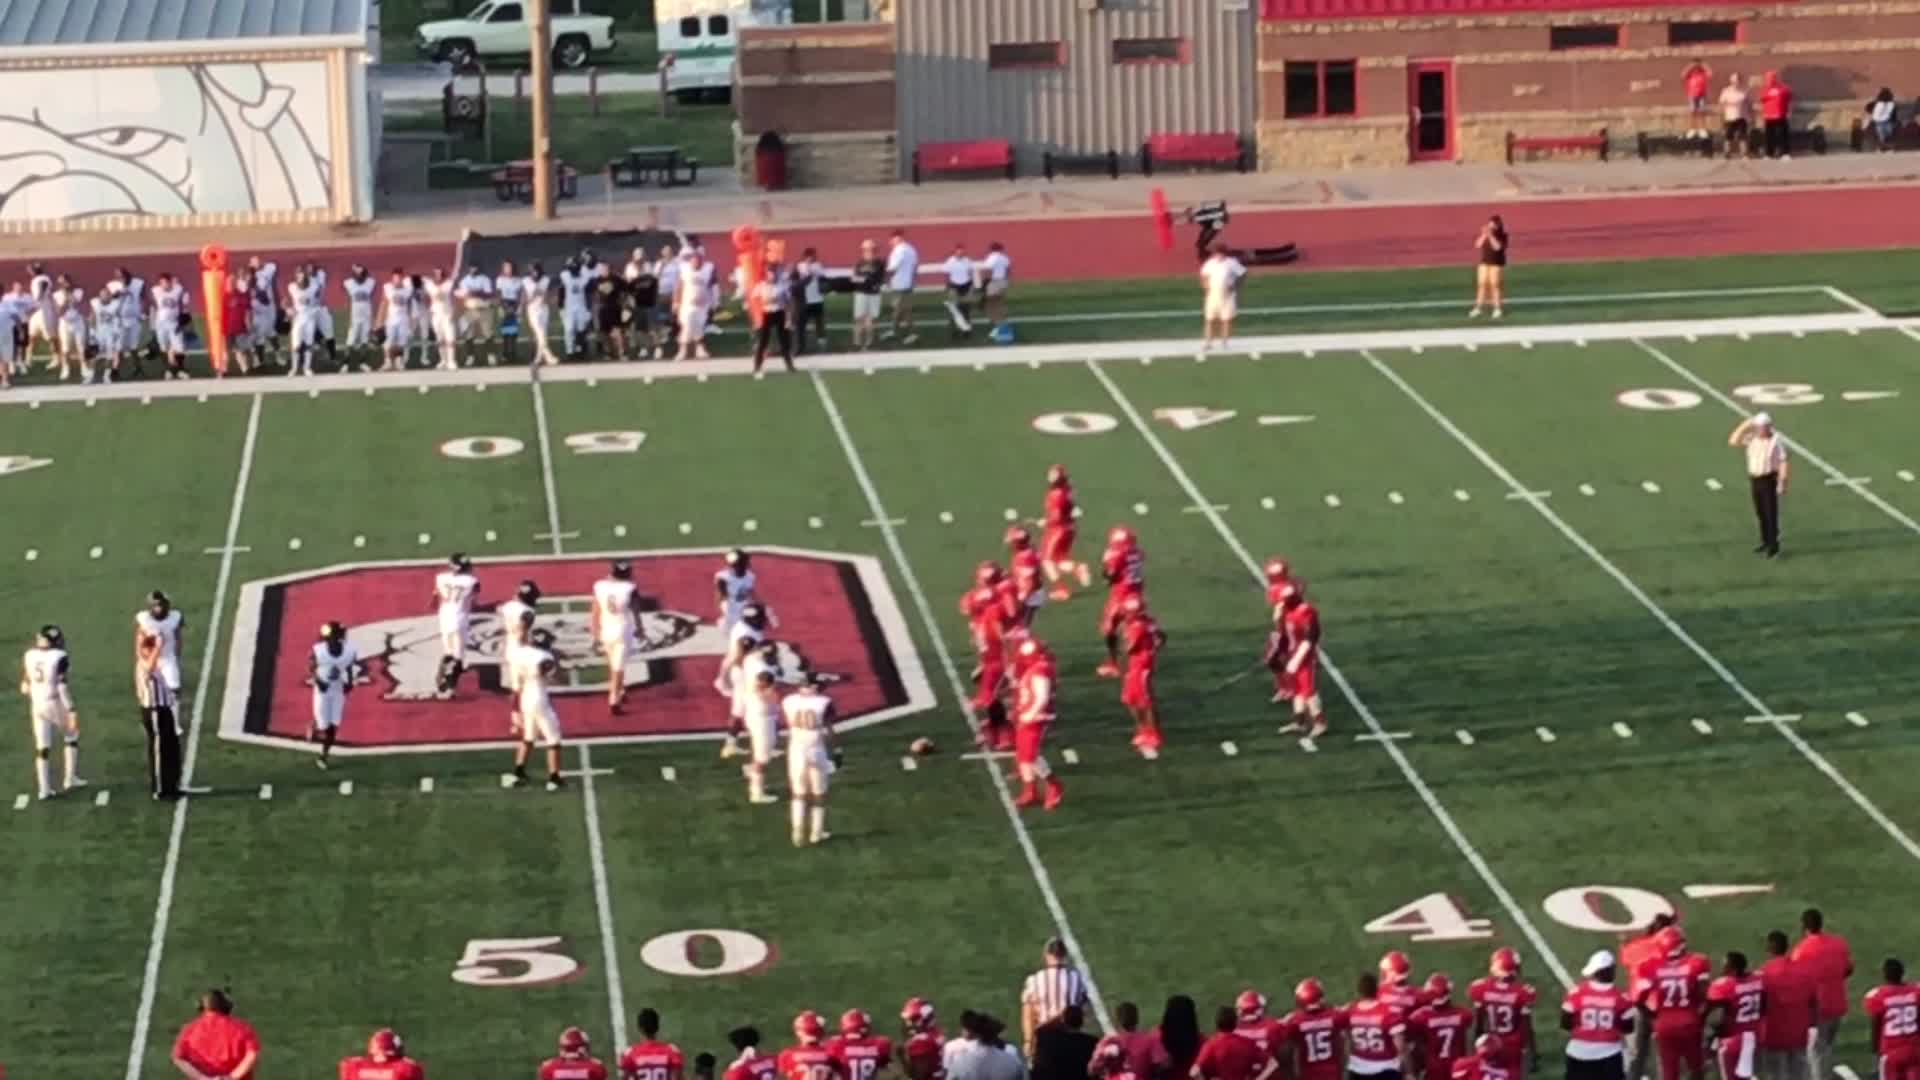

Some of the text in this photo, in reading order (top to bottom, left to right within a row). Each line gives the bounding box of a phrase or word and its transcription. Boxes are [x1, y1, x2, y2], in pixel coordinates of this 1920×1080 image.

[1659, 979, 1690, 1008] 71
[1735, 993, 1761, 1023] 21
[1487, 1004, 1514, 1032] 13
[1883, 1006, 1919, 1036] 28
[1305, 1030, 1333, 1062] 15
[1350, 1027, 1385, 1052] 56
[1437, 1027, 1455, 1058] 7
